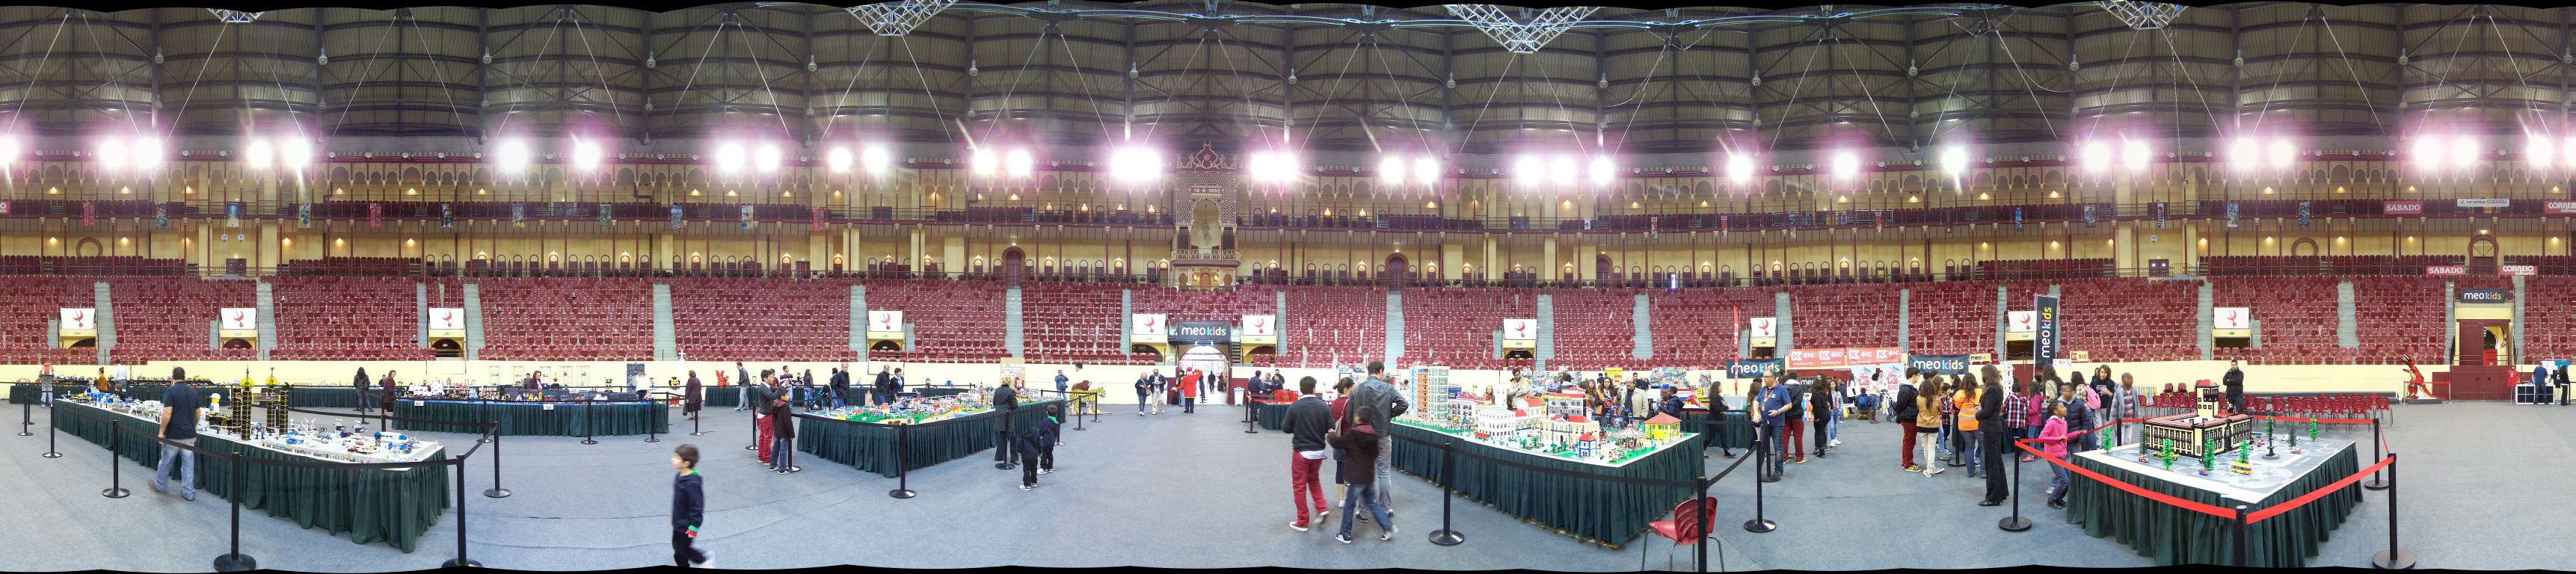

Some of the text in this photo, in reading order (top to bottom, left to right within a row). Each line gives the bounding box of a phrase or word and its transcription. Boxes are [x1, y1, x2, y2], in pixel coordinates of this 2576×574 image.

[1181, 327, 1226, 335] meo kids
[2042, 307, 2052, 358] meo kids
[1731, 364, 1758, 373] meo
[1913, 360, 1964, 370] meo kids
